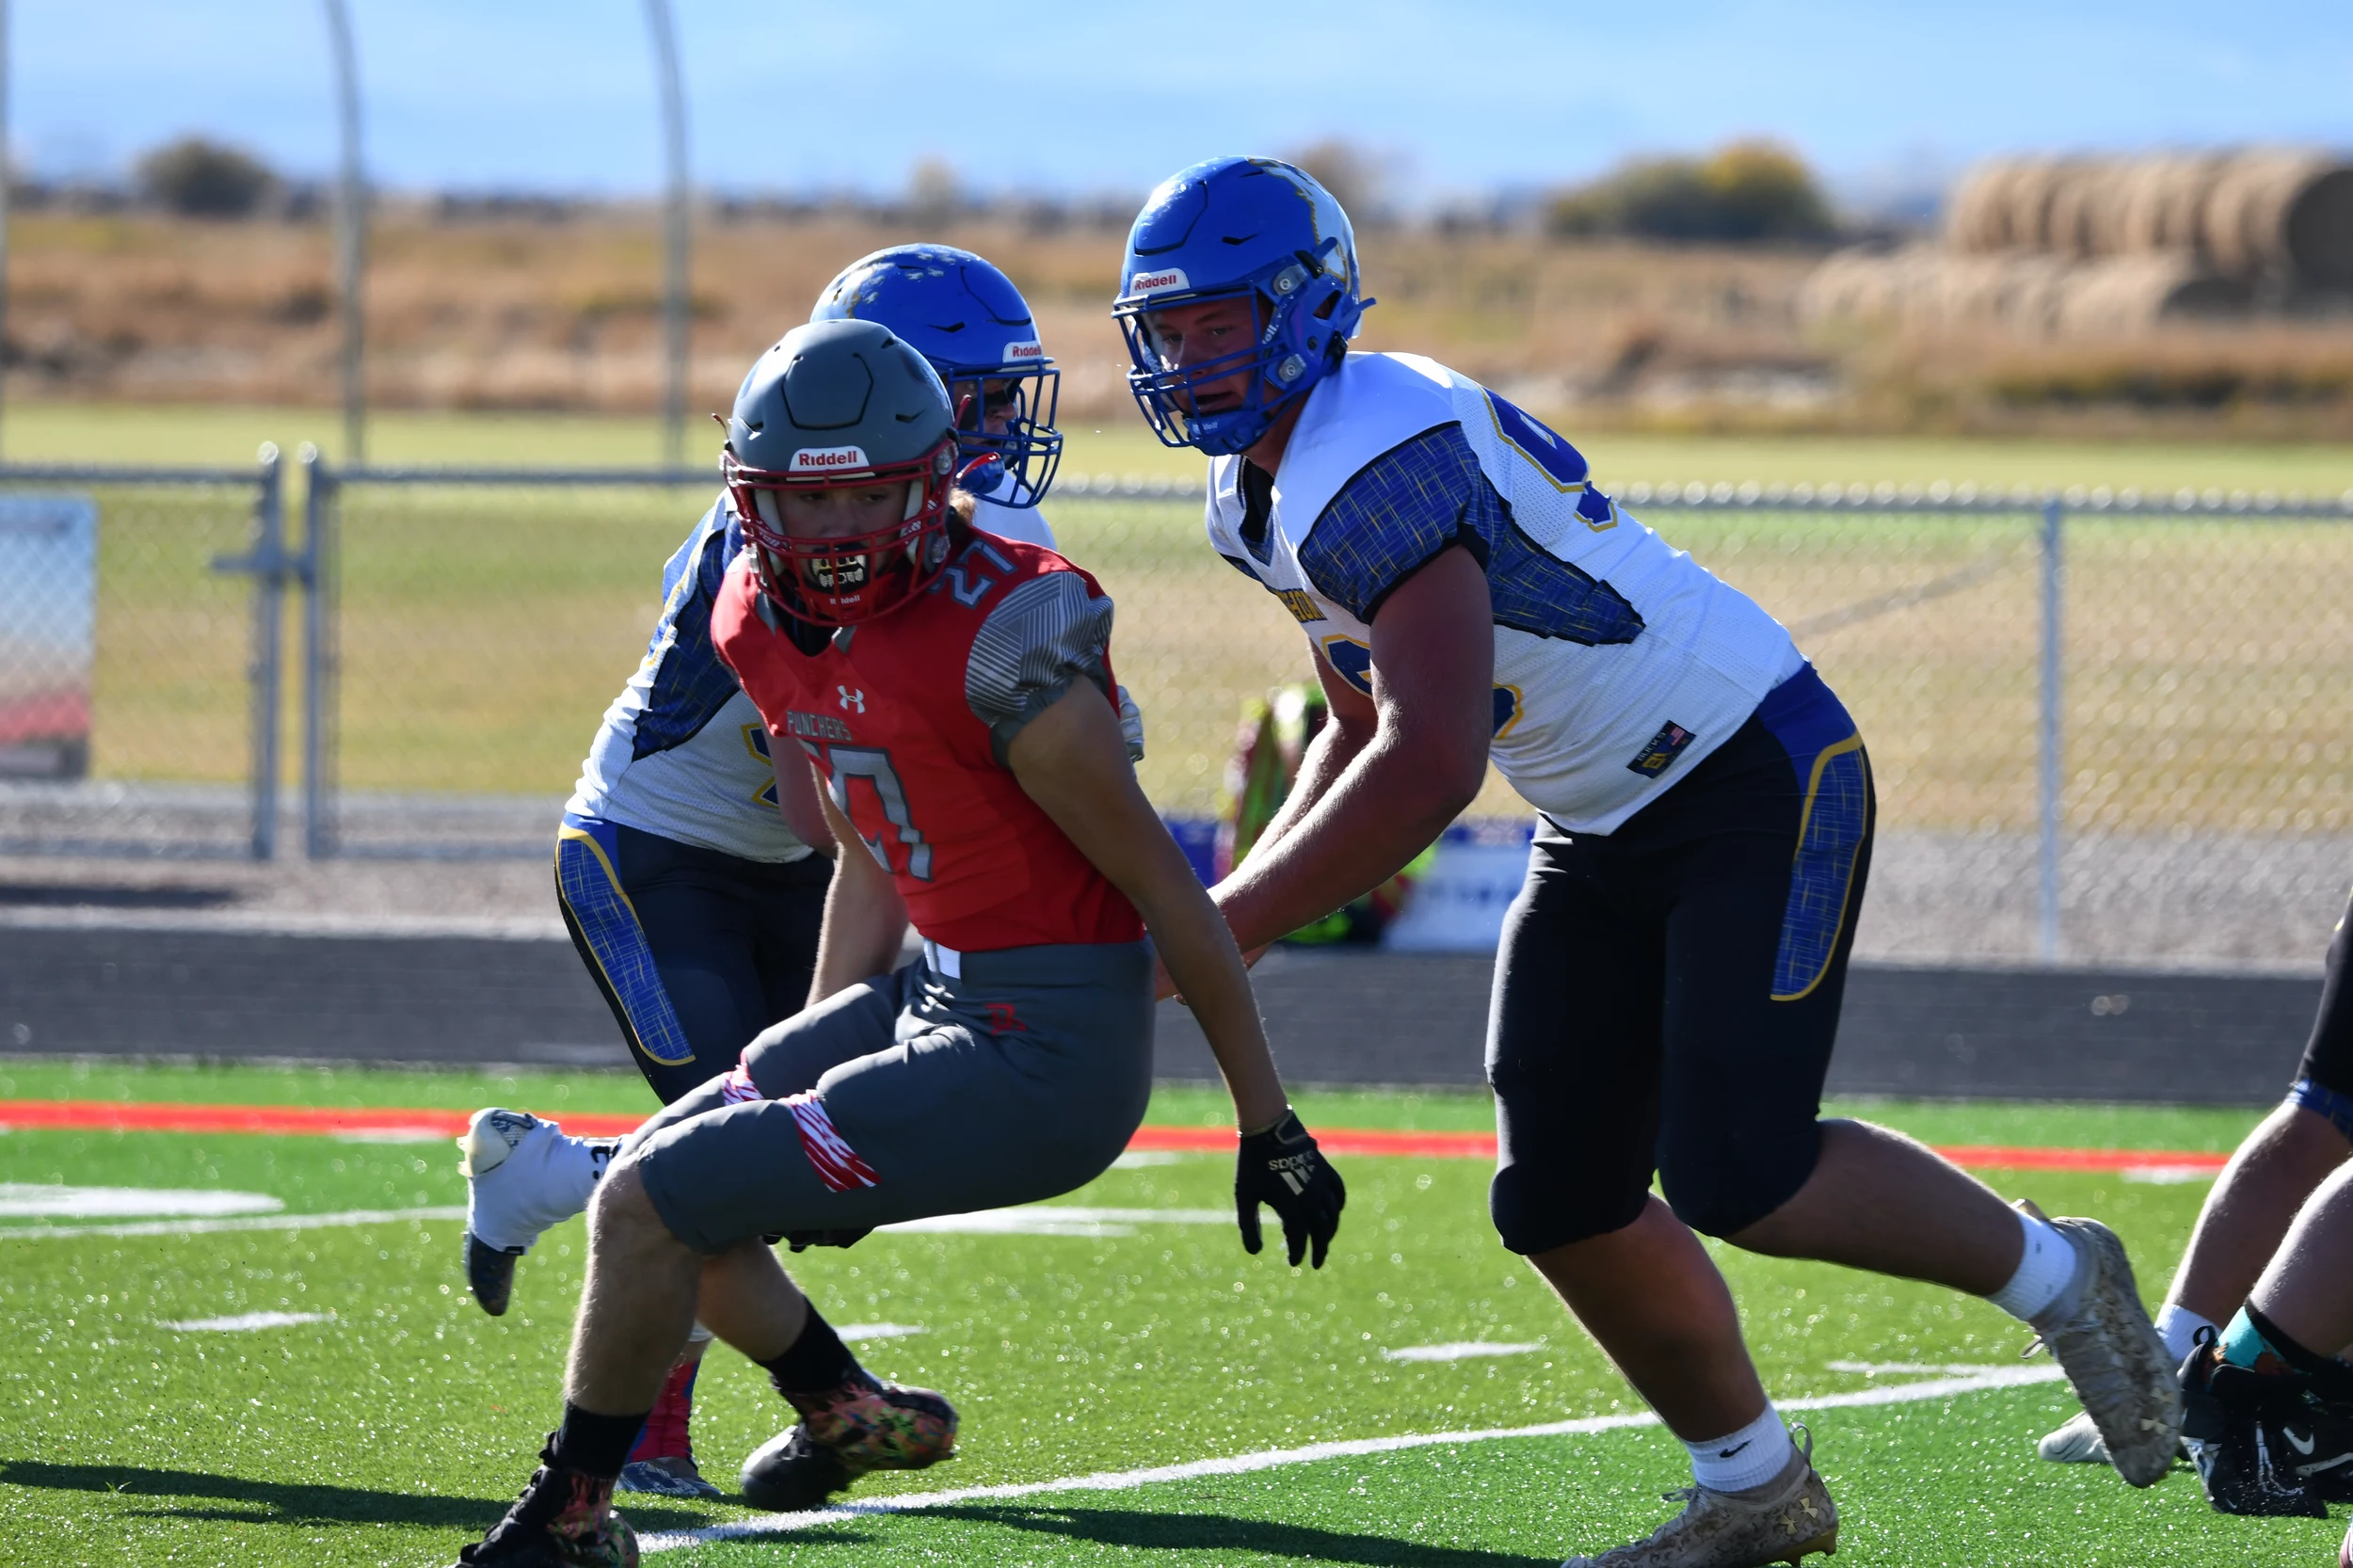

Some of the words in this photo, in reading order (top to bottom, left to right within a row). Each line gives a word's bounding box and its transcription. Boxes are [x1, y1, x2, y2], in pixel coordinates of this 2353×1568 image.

[1134, 274, 1176, 291] Riddell
[798, 450, 857, 467] Riddell
[926, 536, 1019, 610] 27
[784, 710, 853, 742] PUNCHERS
